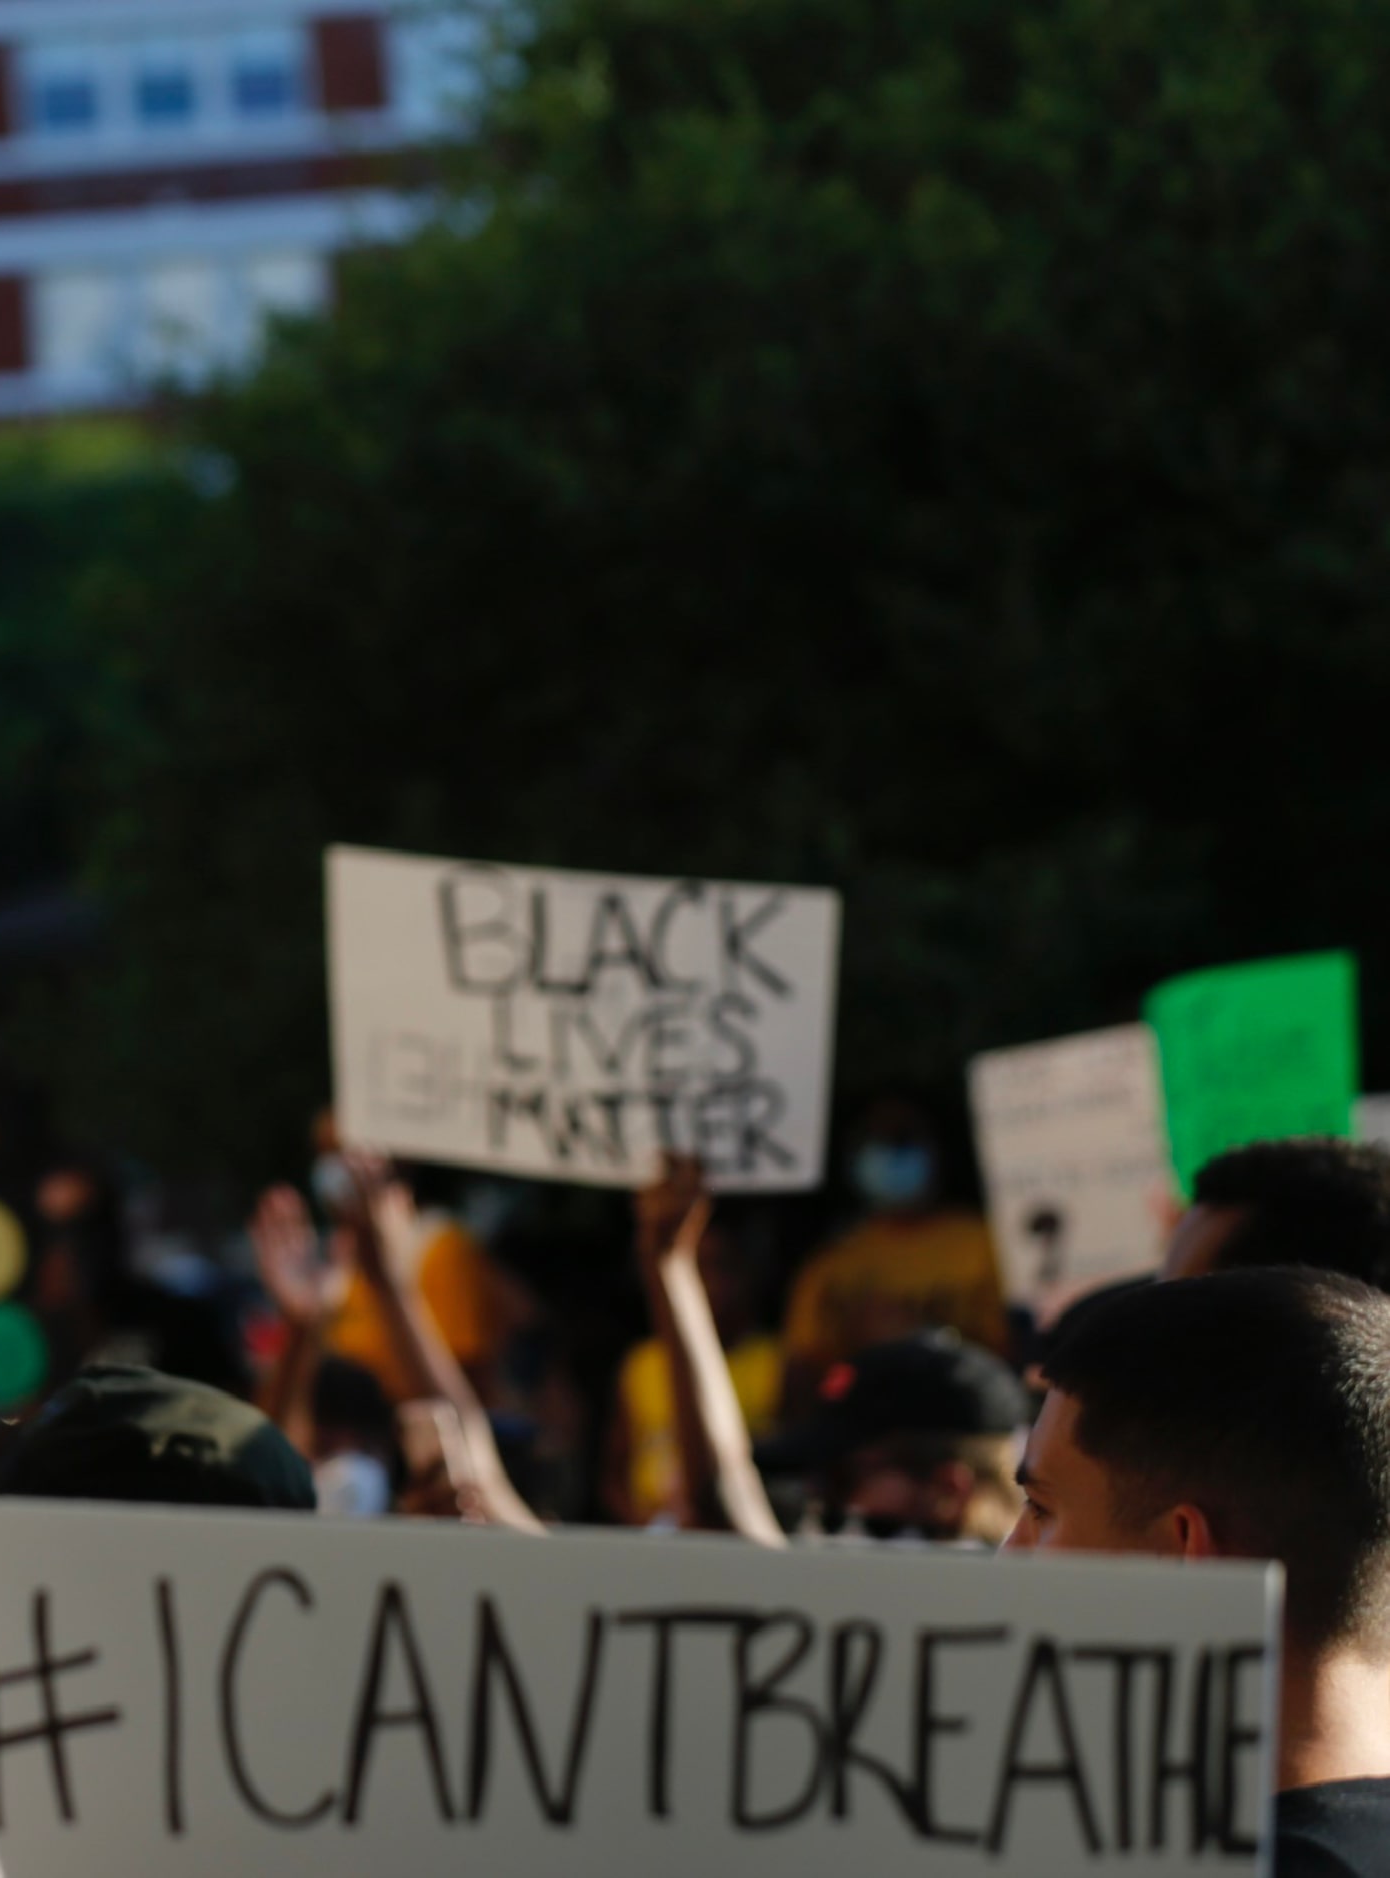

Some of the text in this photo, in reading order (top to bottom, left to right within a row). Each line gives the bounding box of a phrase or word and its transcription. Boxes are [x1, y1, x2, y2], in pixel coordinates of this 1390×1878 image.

[437, 860, 796, 1002] BLACK
[492, 992, 762, 1085] LIVES
[486, 1074, 798, 1174] MATTER
